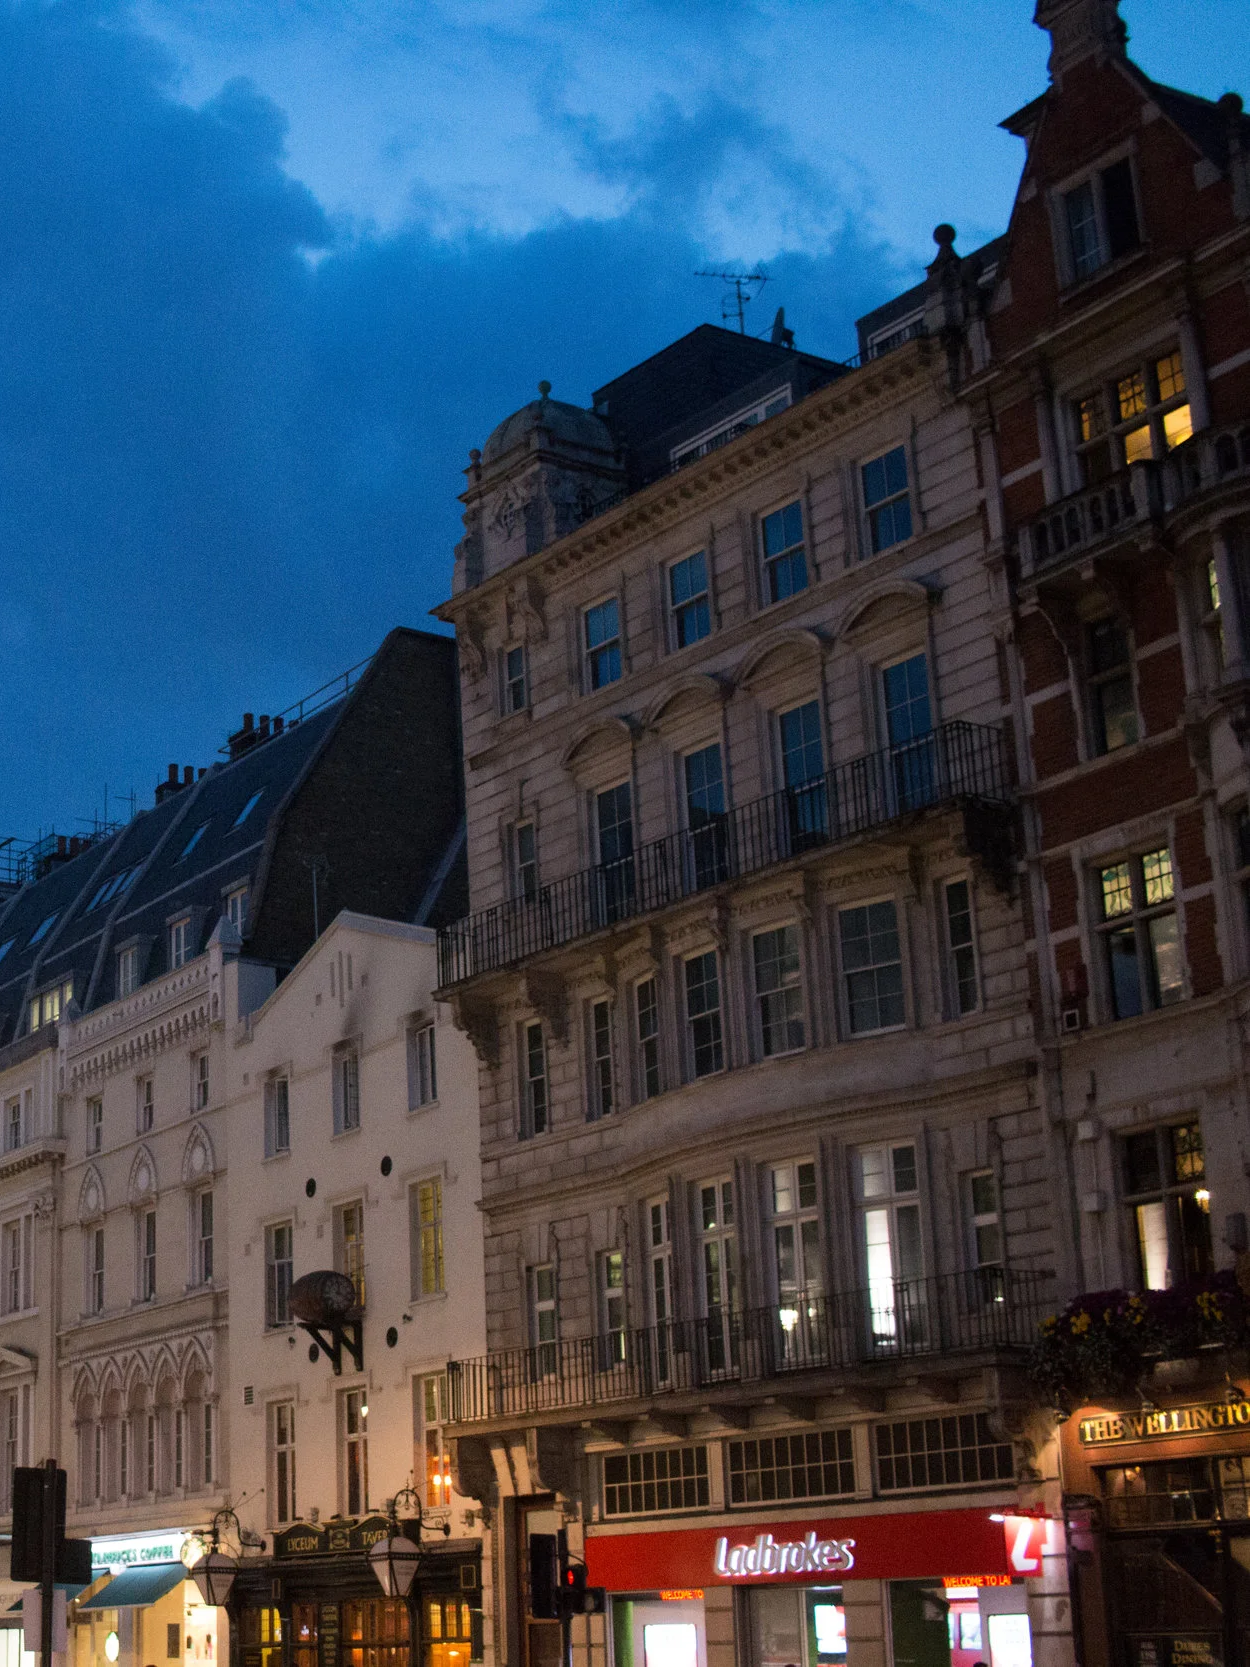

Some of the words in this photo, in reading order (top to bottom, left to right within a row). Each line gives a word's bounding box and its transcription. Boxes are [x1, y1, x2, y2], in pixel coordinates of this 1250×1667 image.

[1080, 1420, 1123, 1442] THE
[287, 1536, 319, 1552] LYCEUM
[361, 1529, 388, 1546] TAVER
[140, 1545, 174, 1561] COFFEE
[713, 1531, 856, 1578] Ladbrokes
[943, 1577, 984, 1588] WELCOME
[986, 1576, 997, 1587] TO
[661, 1590, 693, 1601] WELCOME
[694, 1589, 705, 1599] TO
